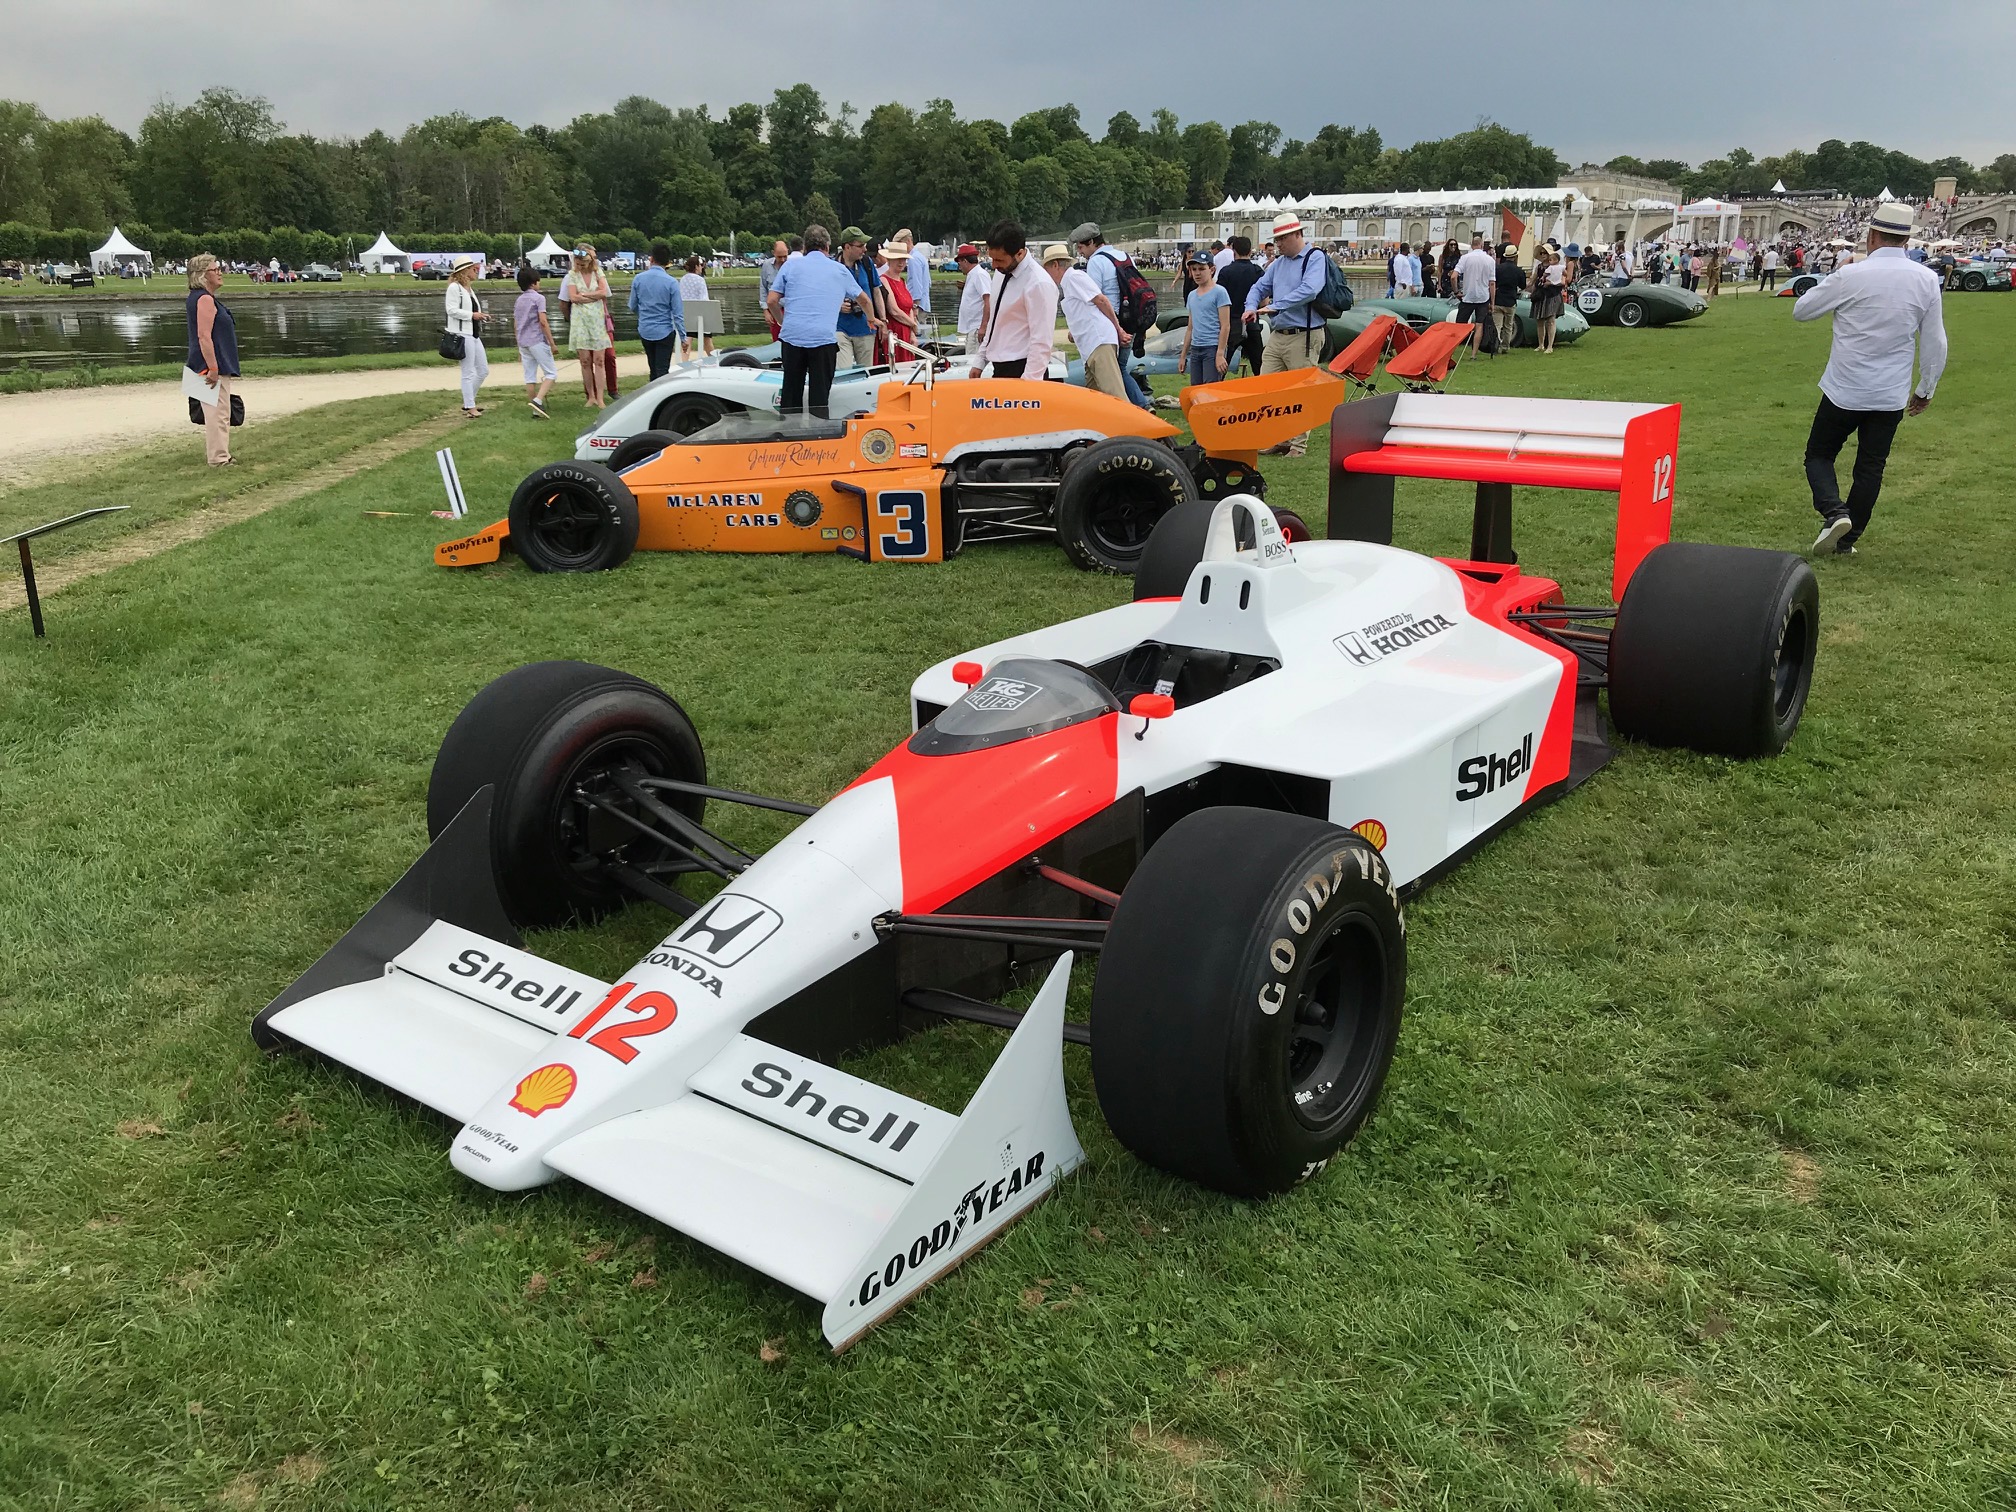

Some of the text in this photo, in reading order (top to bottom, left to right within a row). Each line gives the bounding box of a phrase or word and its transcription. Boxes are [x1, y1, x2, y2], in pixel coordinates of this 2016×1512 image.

[1583, 297, 1597, 305] 233
[970, 397, 1042, 410] McLaren
[1217, 404, 1303, 426] GOODYEAR
[590, 438, 622, 448] SUZ
[748, 442, 840, 471] Johnny Rutherford
[1098, 454, 1188, 505] GOODYE
[1651, 452, 1672, 504] 12
[666, 492, 763, 508] McLAREN
[726, 513, 780, 528] CARS
[876, 489, 930, 559] 3
[441, 535, 494, 555] GOODYEAR
[1264, 540, 1287, 558] BOSS
[1362, 612, 1414, 638] POWERED by
[1370, 614, 1458, 655] HONDA
[987, 680, 1026, 697] TAG
[968, 693, 1018, 708] HEUER
[1456, 732, 1533, 802] Shell
[447, 949, 583, 1015] Shell
[566, 981, 679, 1066] 12
[741, 1062, 921, 1153] Shell
[461, 1145, 492, 1163] McLaren
